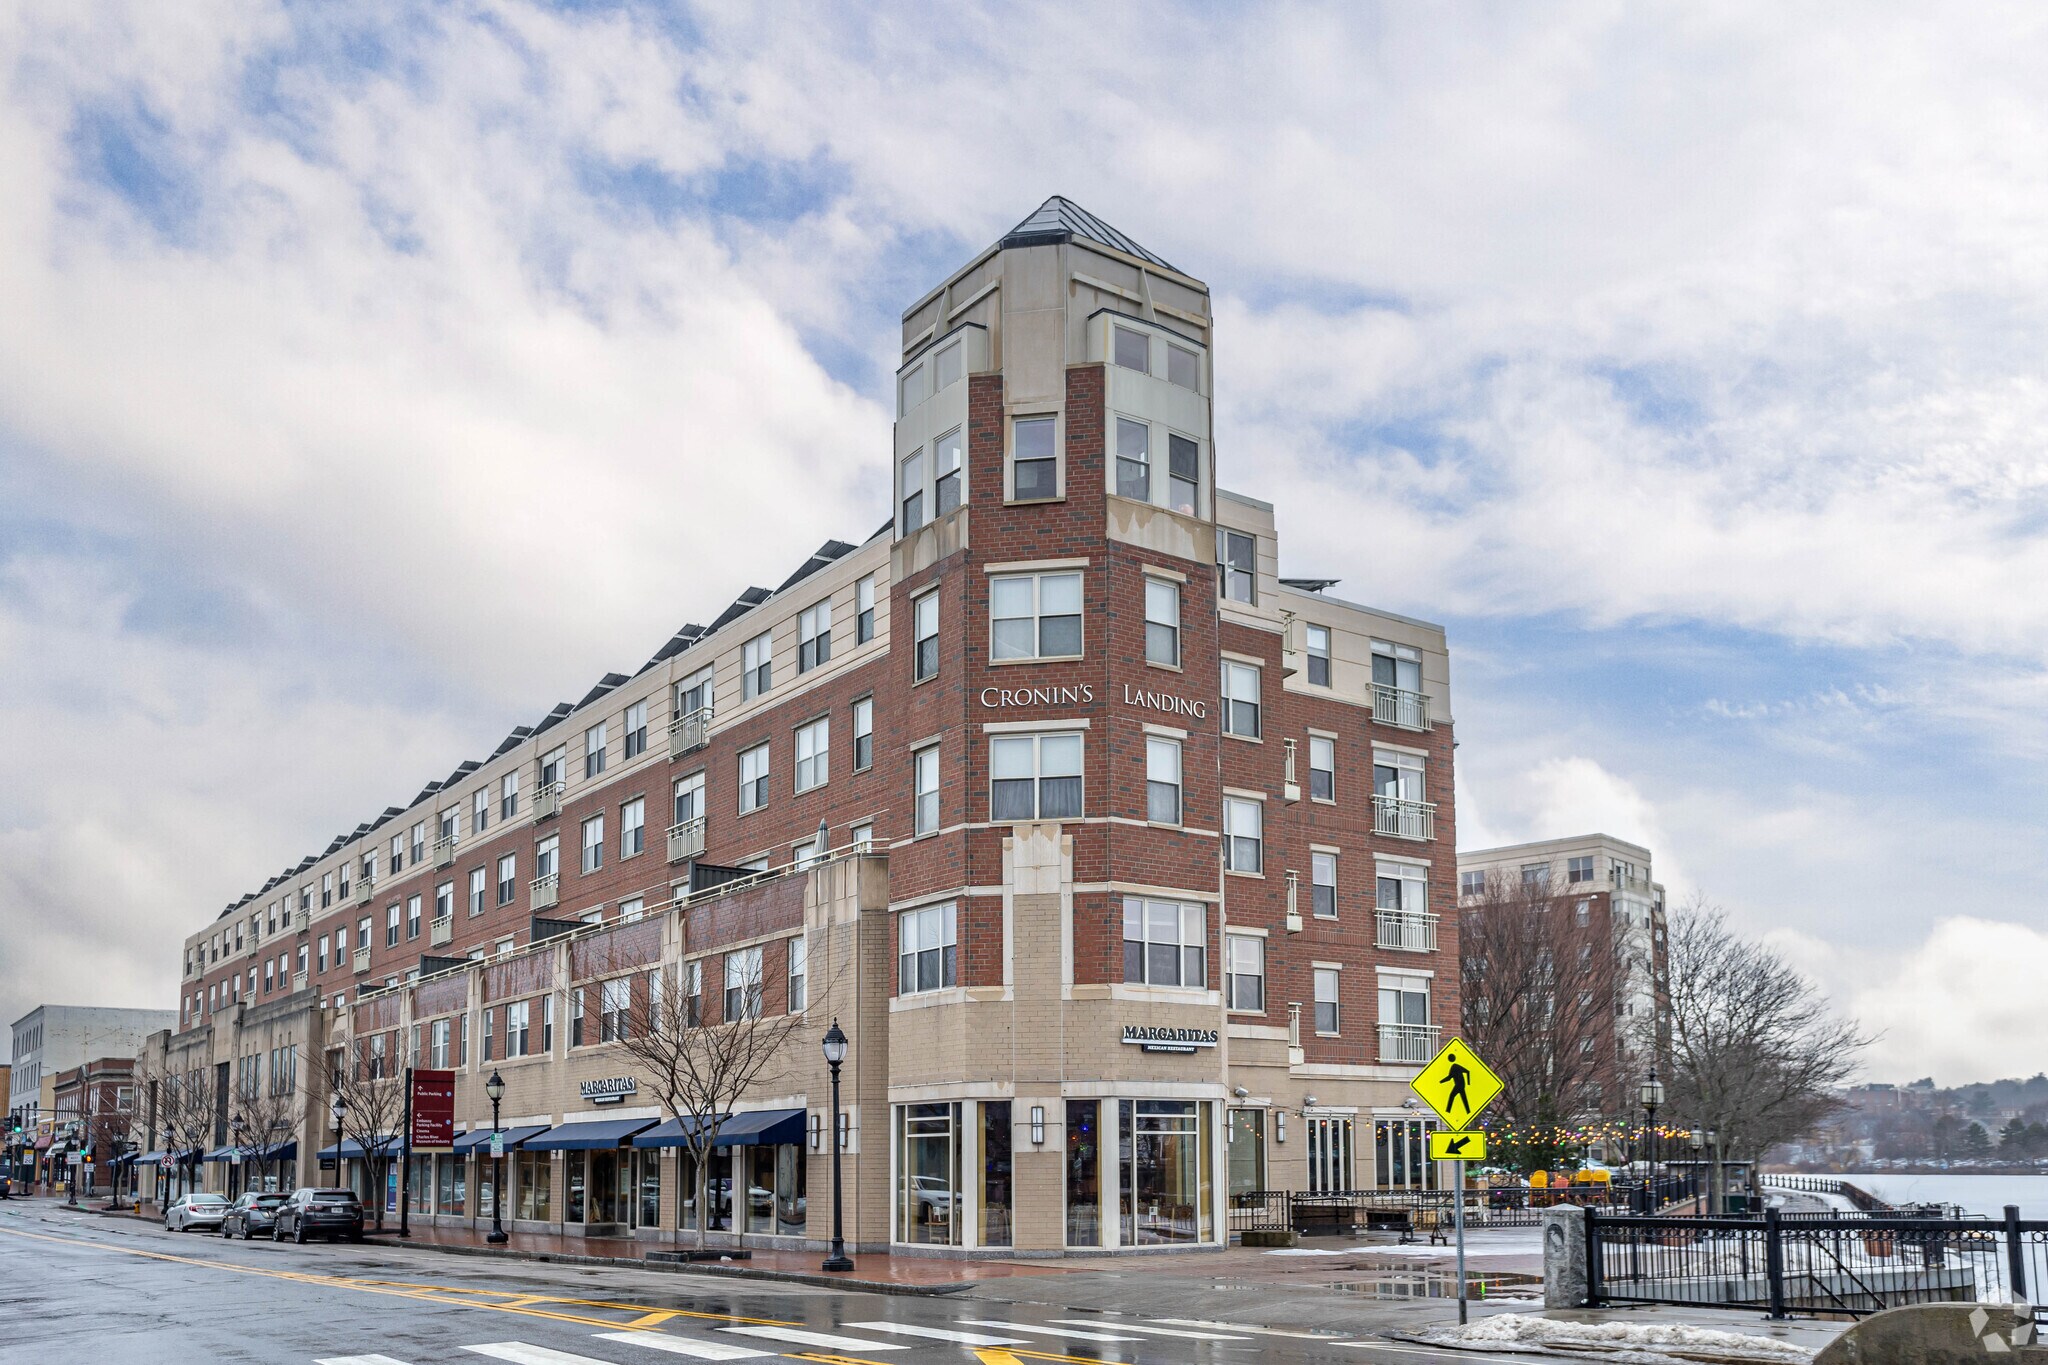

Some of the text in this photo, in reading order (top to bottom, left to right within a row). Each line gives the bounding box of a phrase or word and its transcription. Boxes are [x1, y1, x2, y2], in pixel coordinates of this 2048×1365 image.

[980, 683, 1094, 708] CRONIN'S
[1123, 684, 1206, 719] LANDING
[1123, 1026, 1218, 1042] MARGARITAS
[580, 1076, 635, 1095] MARGARITAS
